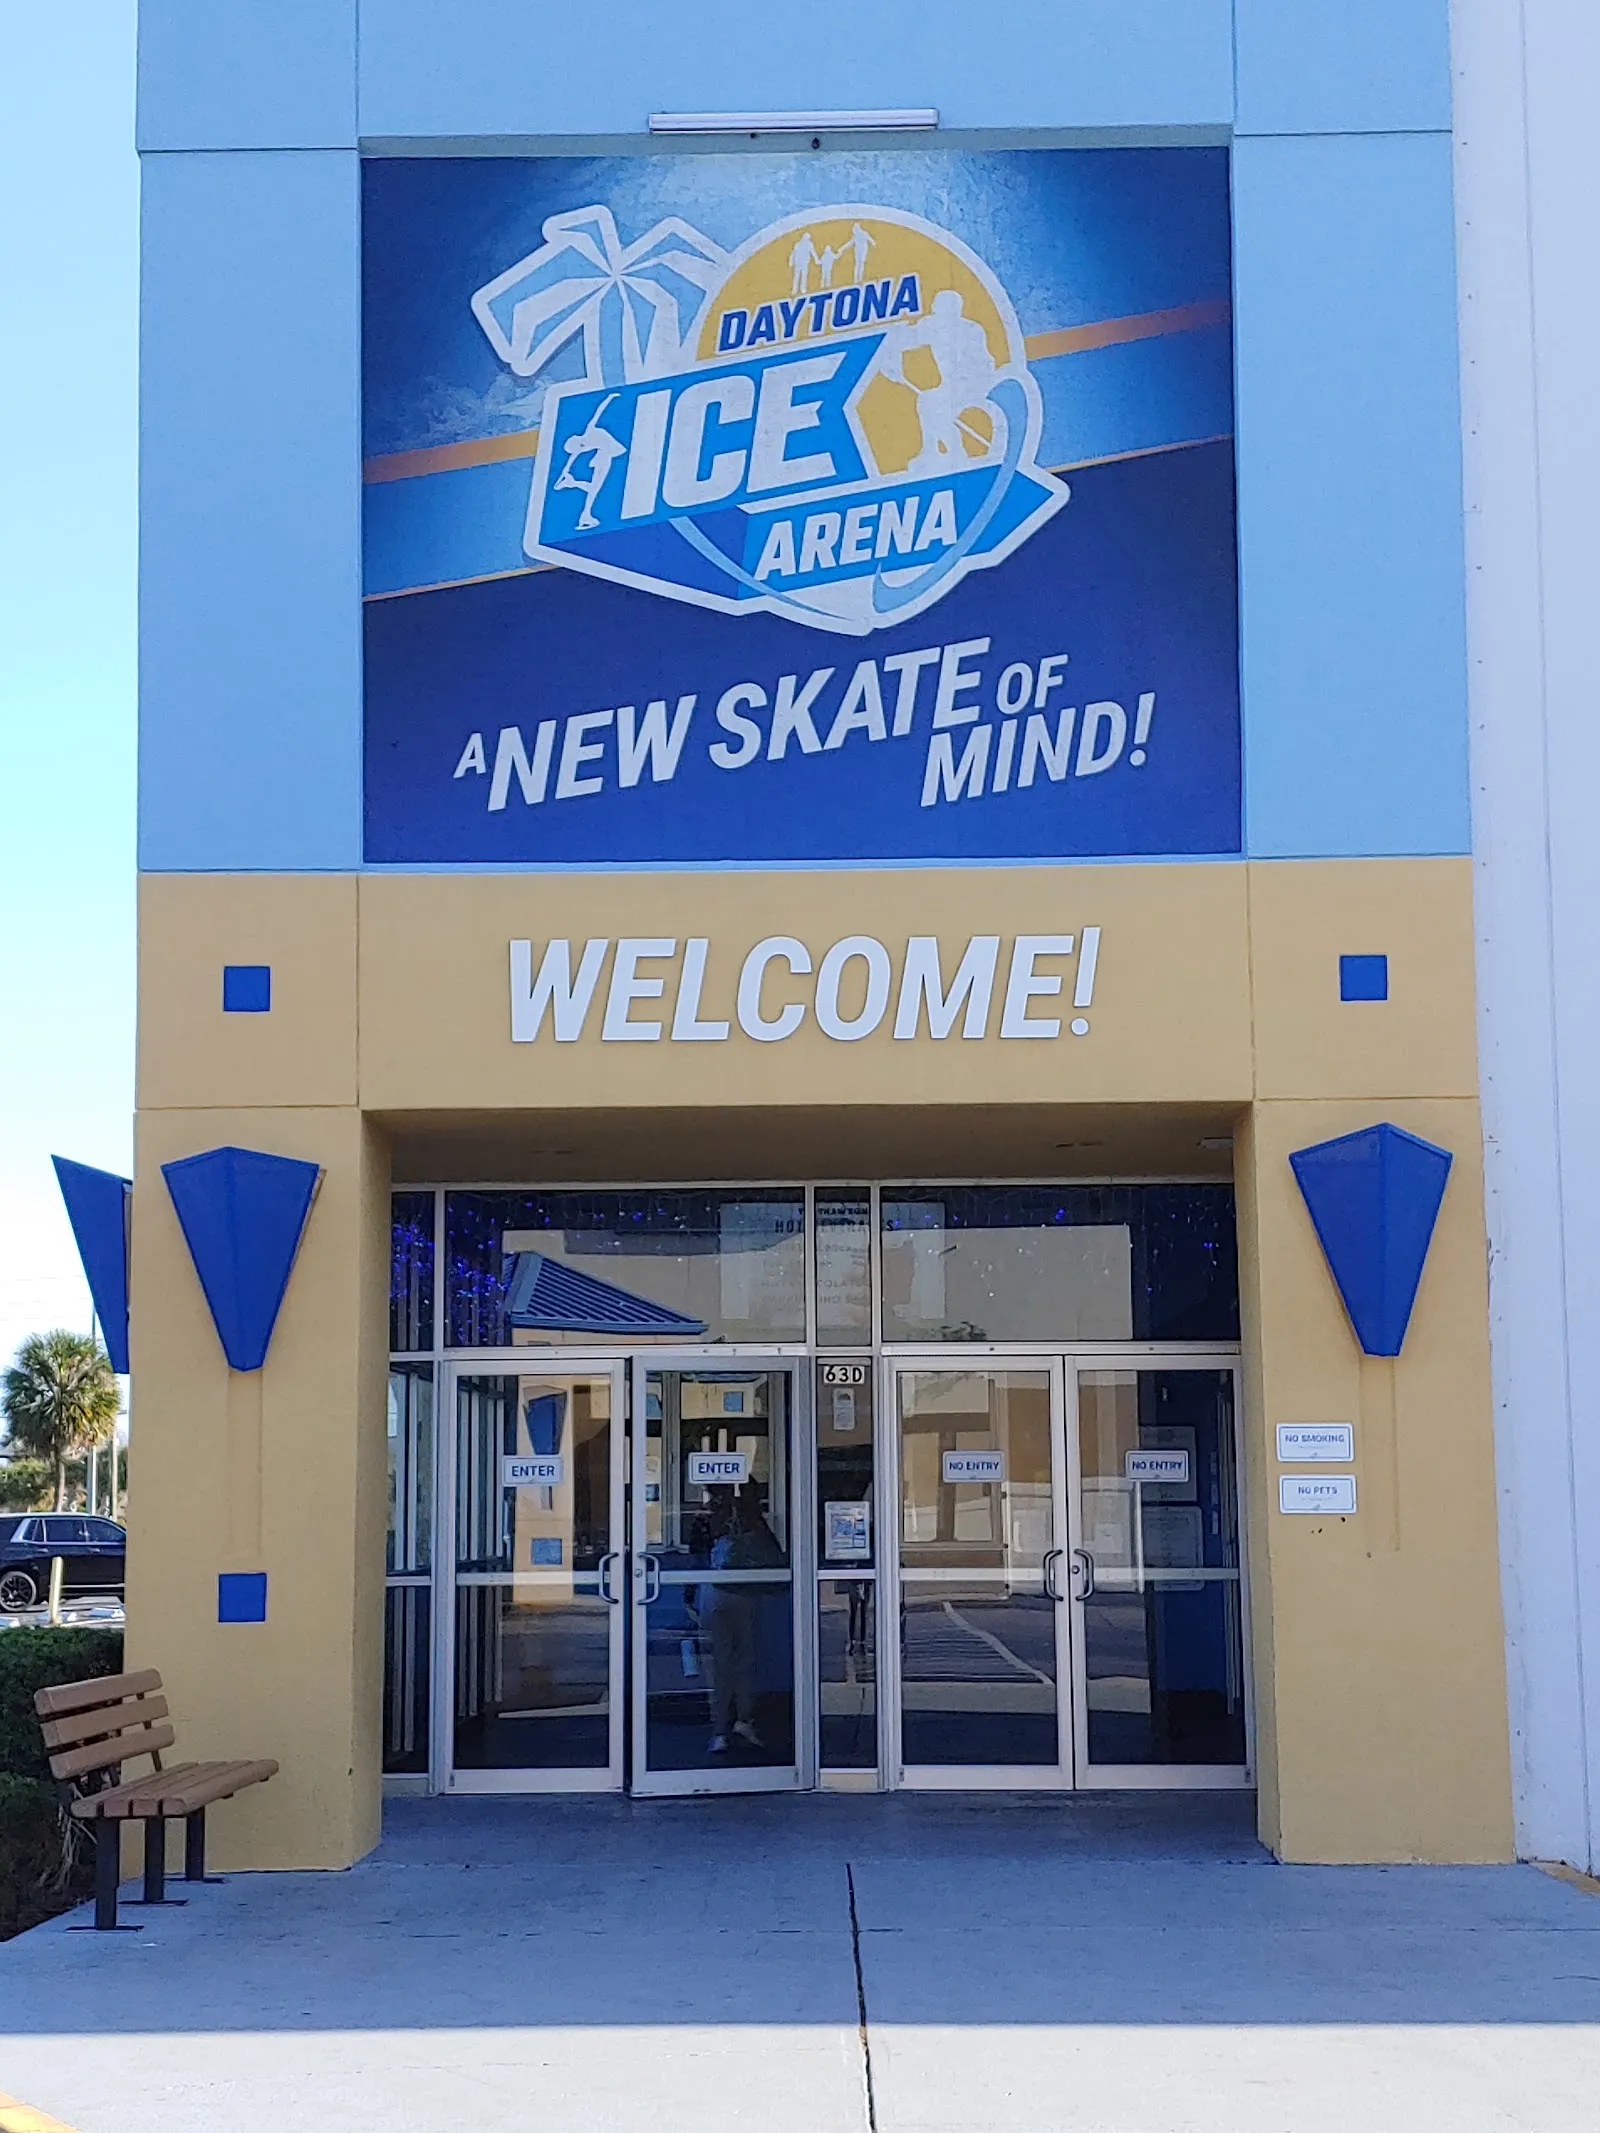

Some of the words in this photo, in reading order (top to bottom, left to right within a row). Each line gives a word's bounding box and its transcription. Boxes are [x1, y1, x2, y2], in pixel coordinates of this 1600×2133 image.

[719, 275, 922, 354] DAYTONA
[620, 354, 846, 520] ICE
[754, 488, 959, 584] ARENA
[454, 733, 486, 778] A
[488, 696, 694, 812] NEW
[708, 637, 992, 771] SKATE
[997, 654, 1068, 716] OF
[921, 692, 1155, 806] MIND!
[510, 927, 1101, 1045] WELCOME!
[825, 1366, 863, 1384] 63D
[1285, 1434, 1299, 1442] NO
[1301, 1434, 1345, 1442] SMOKING
[511, 1465, 555, 1478] ENTER
[698, 1462, 740, 1474] ENTER
[949, 1461, 963, 1471] NO
[966, 1461, 999, 1472] ENTRY
[1132, 1460, 1146, 1470] NO
[1149, 1460, 1183, 1470] ENTRY
[1298, 1486, 1311, 1494] NO
[1313, 1486, 1338, 1494] PETS
